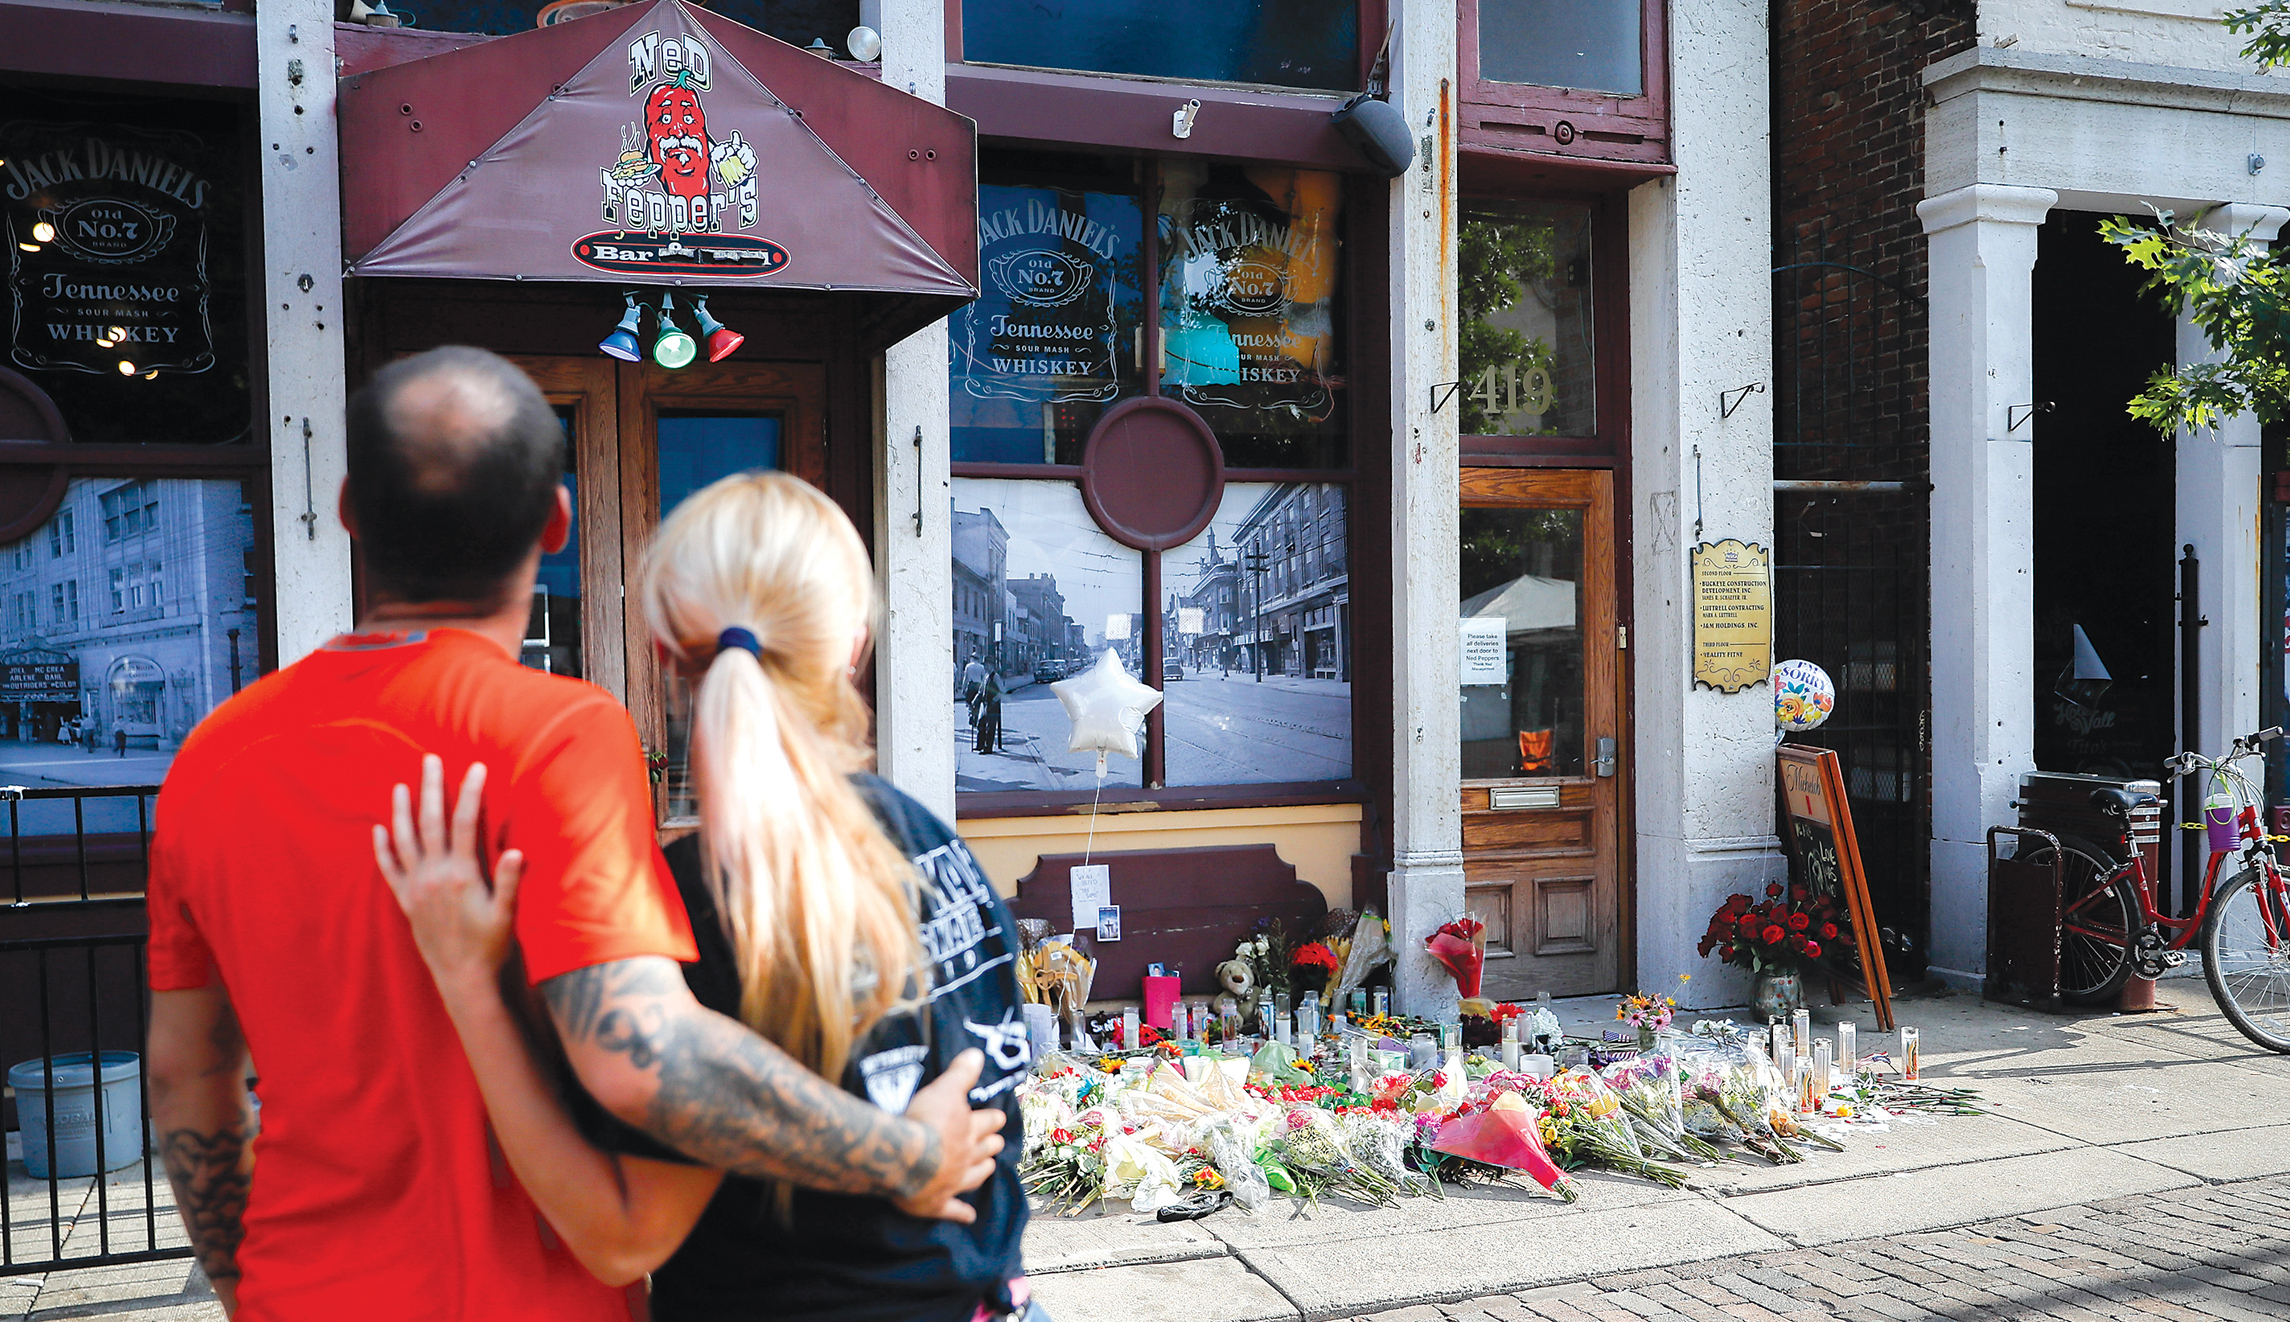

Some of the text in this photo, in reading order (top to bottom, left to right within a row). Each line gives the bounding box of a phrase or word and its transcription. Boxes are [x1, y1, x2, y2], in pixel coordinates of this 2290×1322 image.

[5, 147, 84, 201] JACK
[91, 209, 122, 220] Old
[77, 220, 139, 240] No.7
[979, 207, 1025, 250] ACK
[1181, 221, 1237, 264] JACK
[593, 246, 654, 261] Bar
[1028, 259, 1052, 268] Old
[1018, 269, 1065, 286] No.7
[1241, 271, 1264, 280] Old
[43, 273, 180, 302] Tennessee
[1231, 280, 1274, 297] No.7
[78, 308, 150, 318] SOUR MASH
[47, 324, 179, 343] WHISKEY
[990, 314, 1093, 340] Tennessee
[1015, 344, 1070, 354] SOUR MASH
[1255, 354, 1281, 362] MASH
[992, 358, 1093, 376] WHISKEY
[1220, 366, 1301, 383] ISKEY
[1470, 364, 1552, 417] 419
[10, 673, 63, 682] ARLENE DAHL
[34, 666, 45, 674] MC
[46, 665, 65, 673] CREA
[10, 681, 48, 690] OUTRIDERS
[1781, 666, 1826, 691] SORRY
